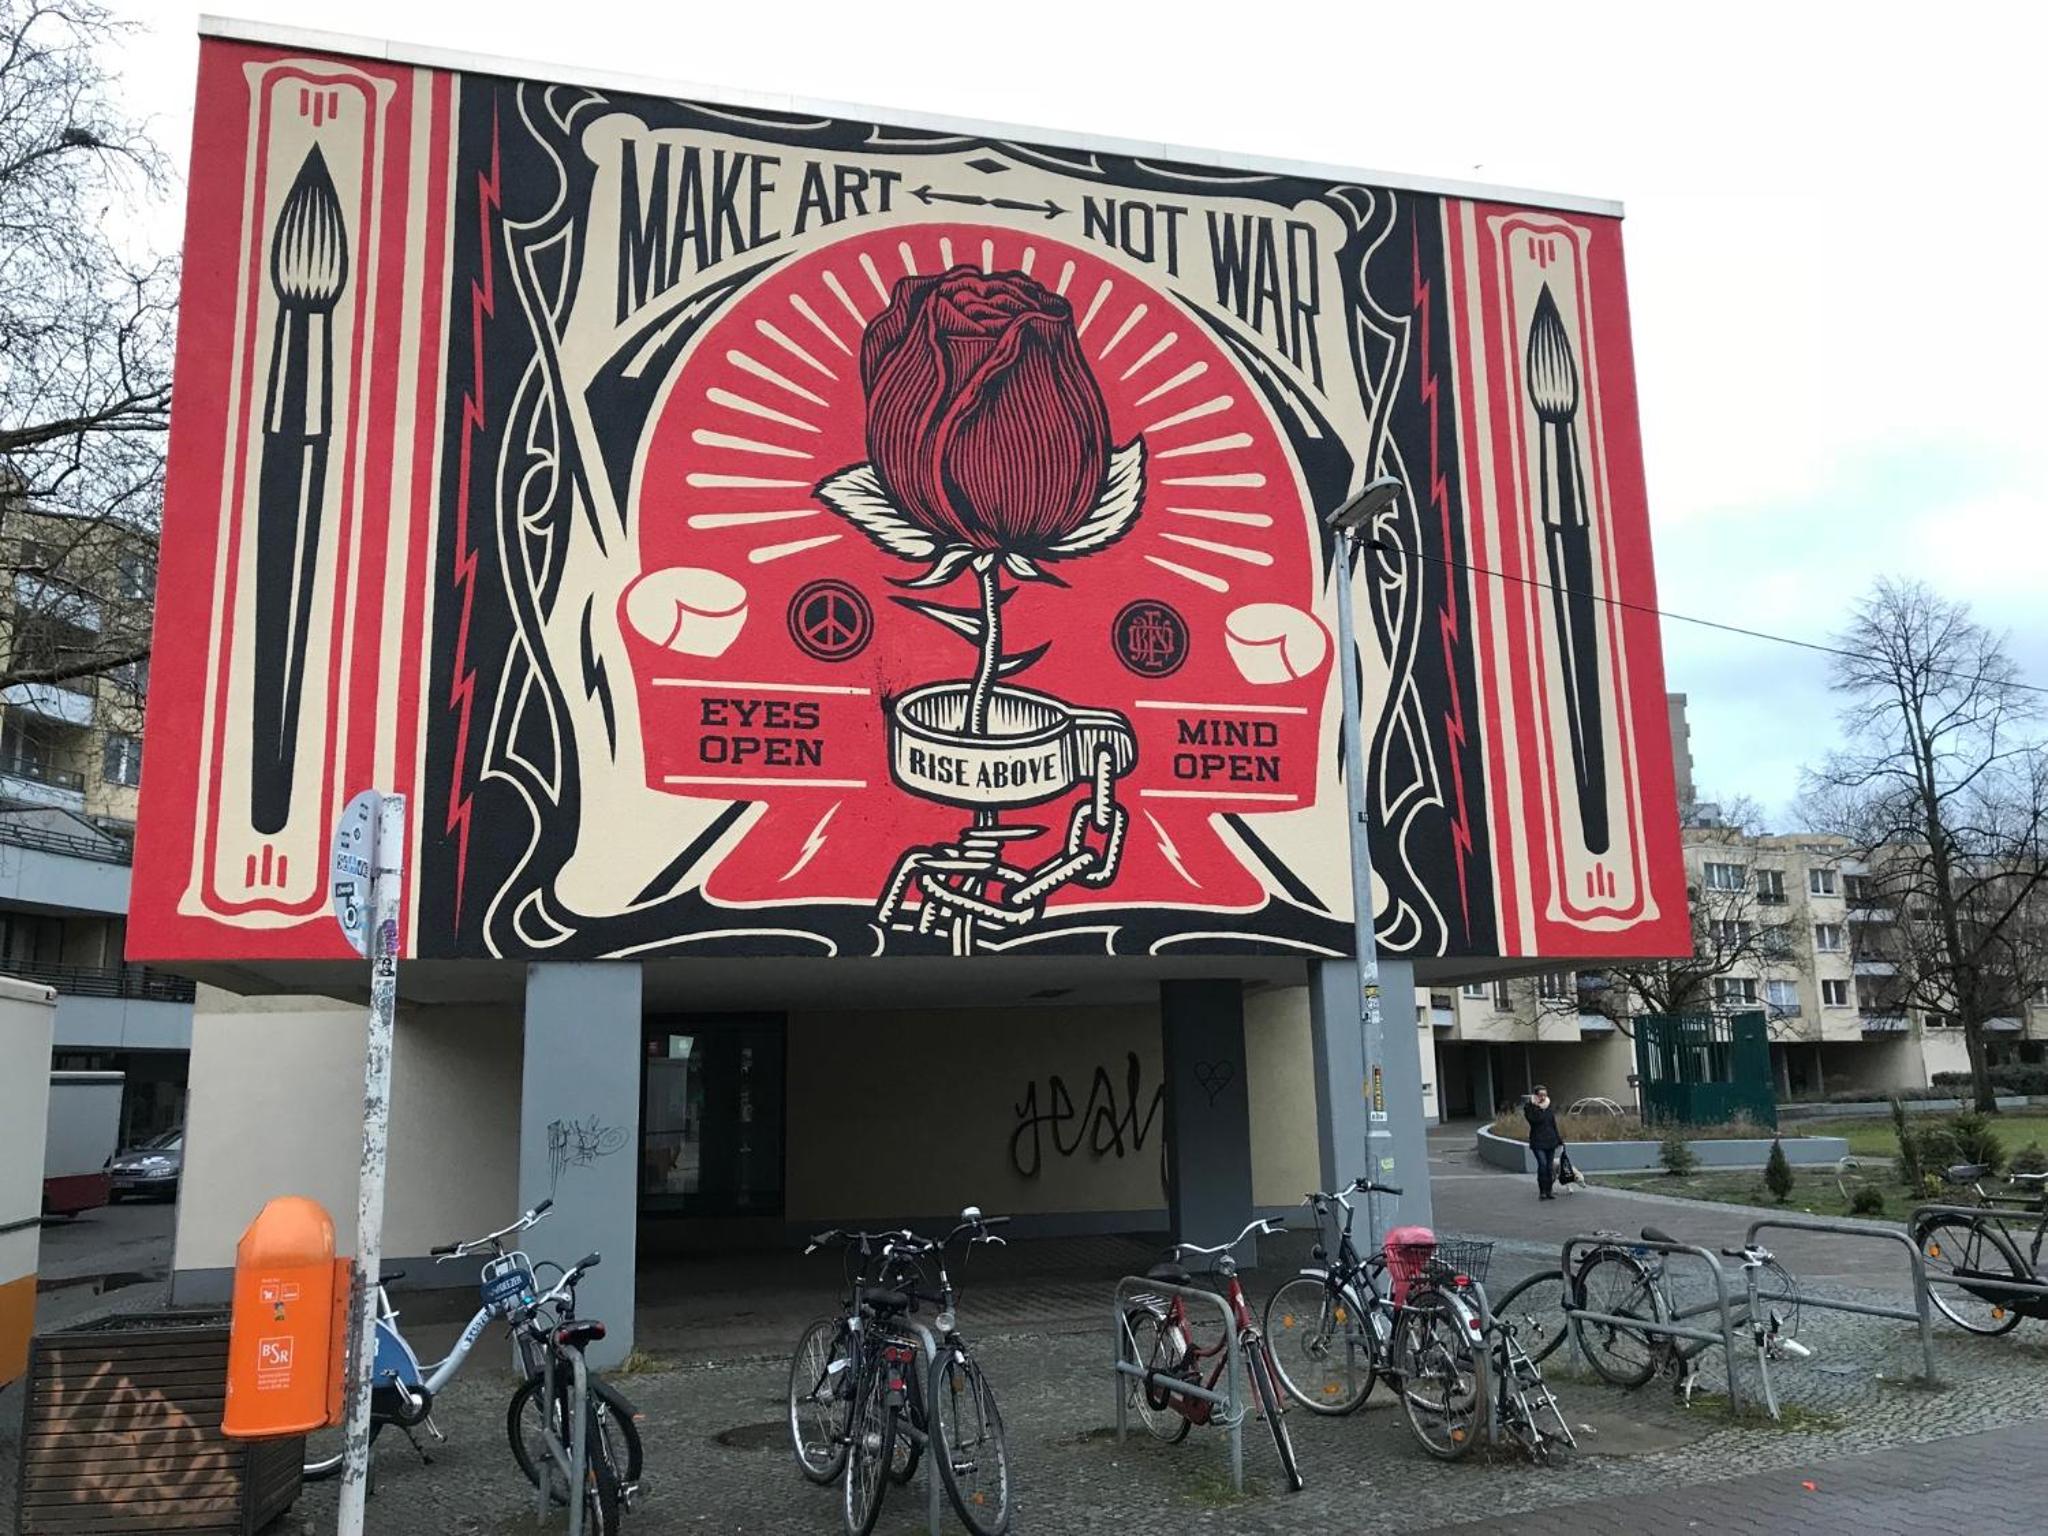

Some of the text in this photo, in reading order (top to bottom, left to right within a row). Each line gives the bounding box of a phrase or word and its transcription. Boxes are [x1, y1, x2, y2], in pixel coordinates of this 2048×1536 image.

[614, 138, 1330, 401] MAKE ART NOT WAR
[700, 698, 820, 729] EYES
[1177, 718, 1278, 747] MIND
[700, 735, 824, 766] OPEN
[910, 747, 1057, 789] RISE ABOVE
[1173, 753, 1281, 782] OPEN
[262, 1343, 289, 1364] BSR
